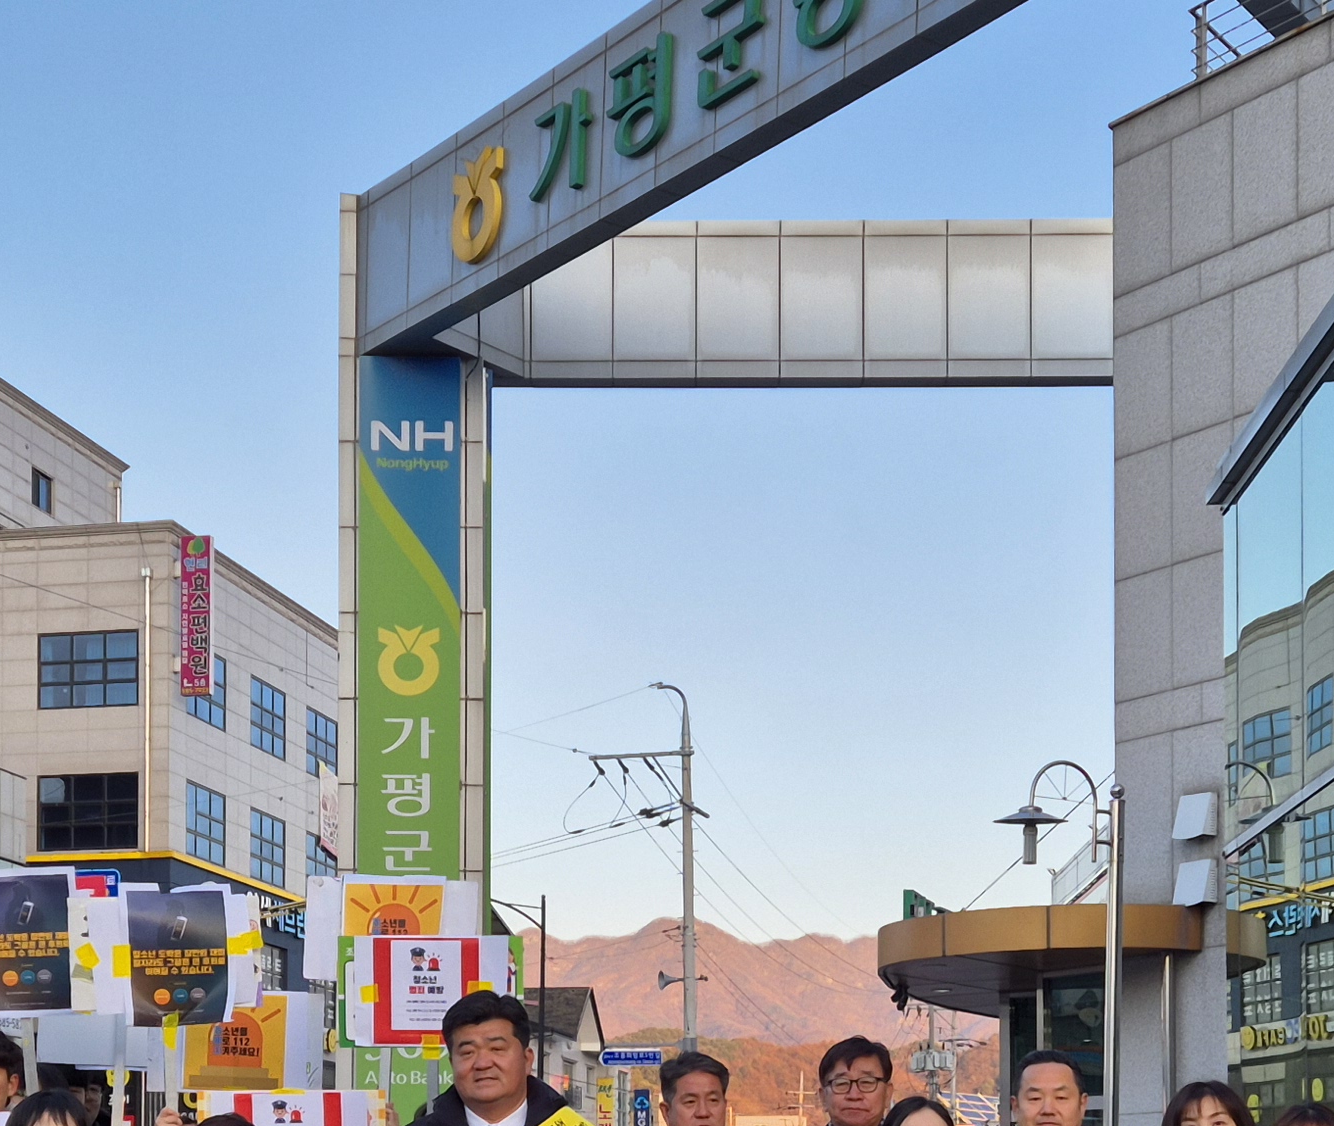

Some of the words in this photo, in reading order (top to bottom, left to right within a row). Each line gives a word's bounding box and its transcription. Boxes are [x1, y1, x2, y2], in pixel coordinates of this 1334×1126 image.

[370, 420, 454, 453] NH
[376, 456, 450, 472] NongHyup
[190, 573, 209, 611] 효소
[190, 614, 209, 677] 편백원
[233, 1038, 250, 1046] 112
[364, 1070, 407, 1085] Ato
